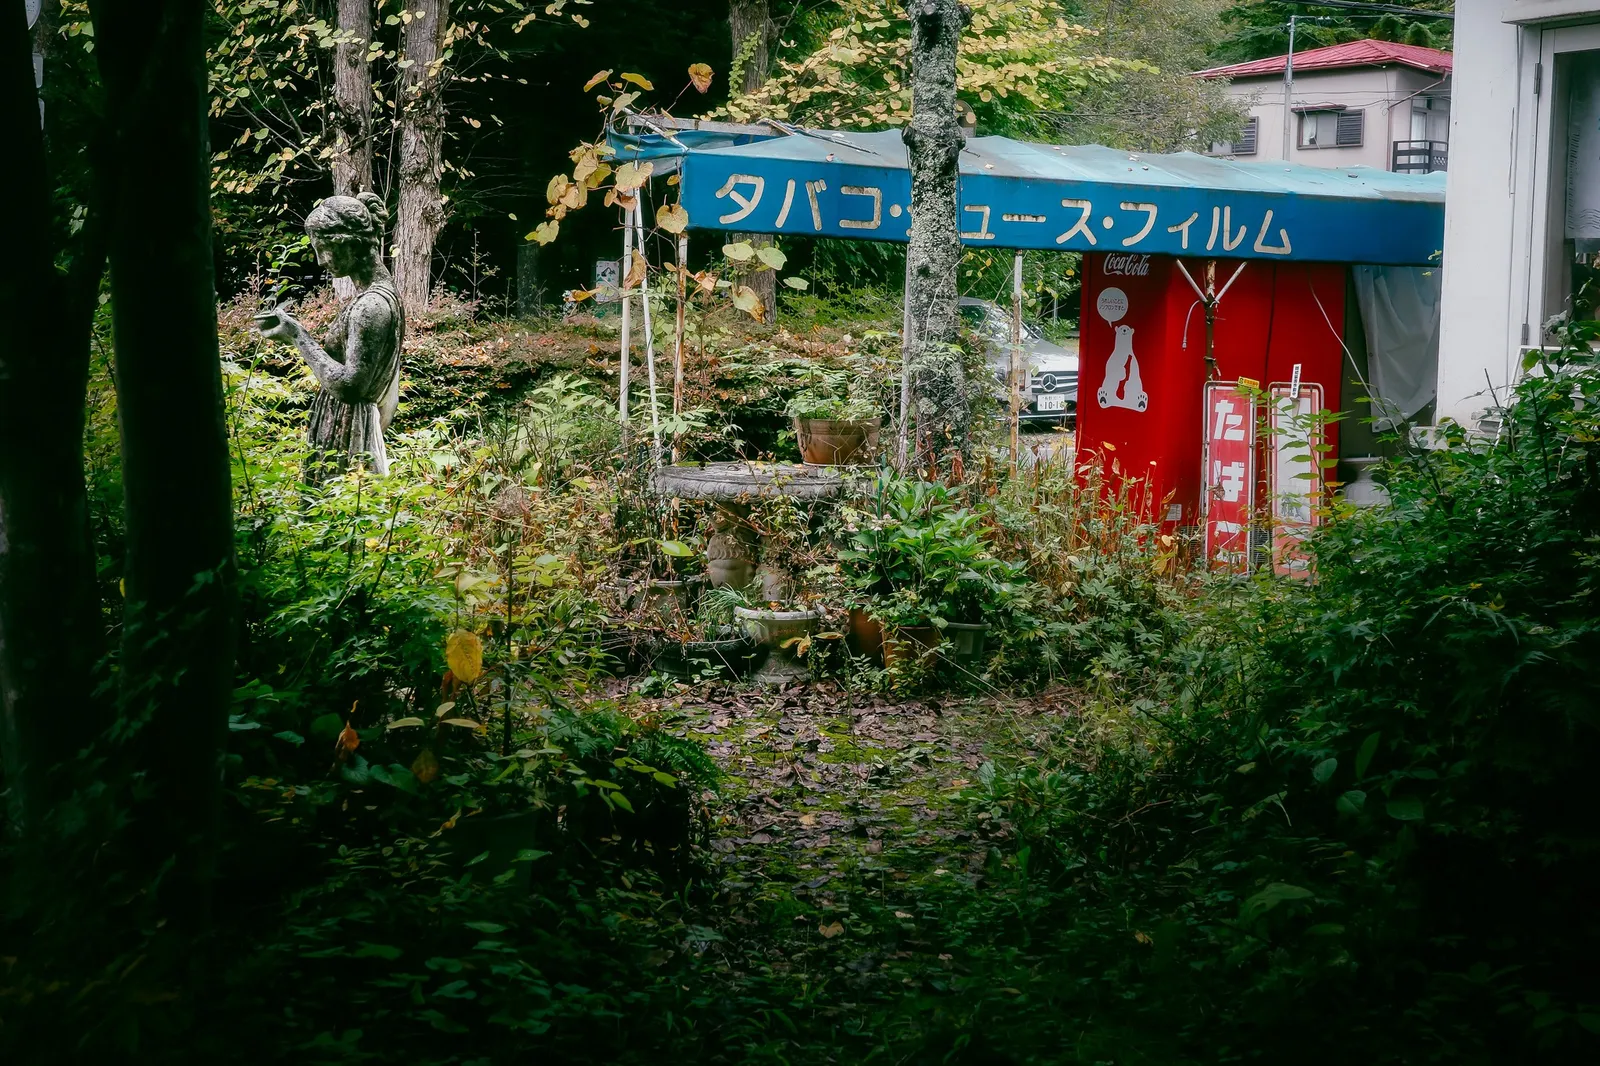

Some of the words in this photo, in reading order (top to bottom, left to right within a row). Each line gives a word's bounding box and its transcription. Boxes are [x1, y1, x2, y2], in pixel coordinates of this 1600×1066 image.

[715, 173, 1292, 255] タバコ・ュース・フィルム
